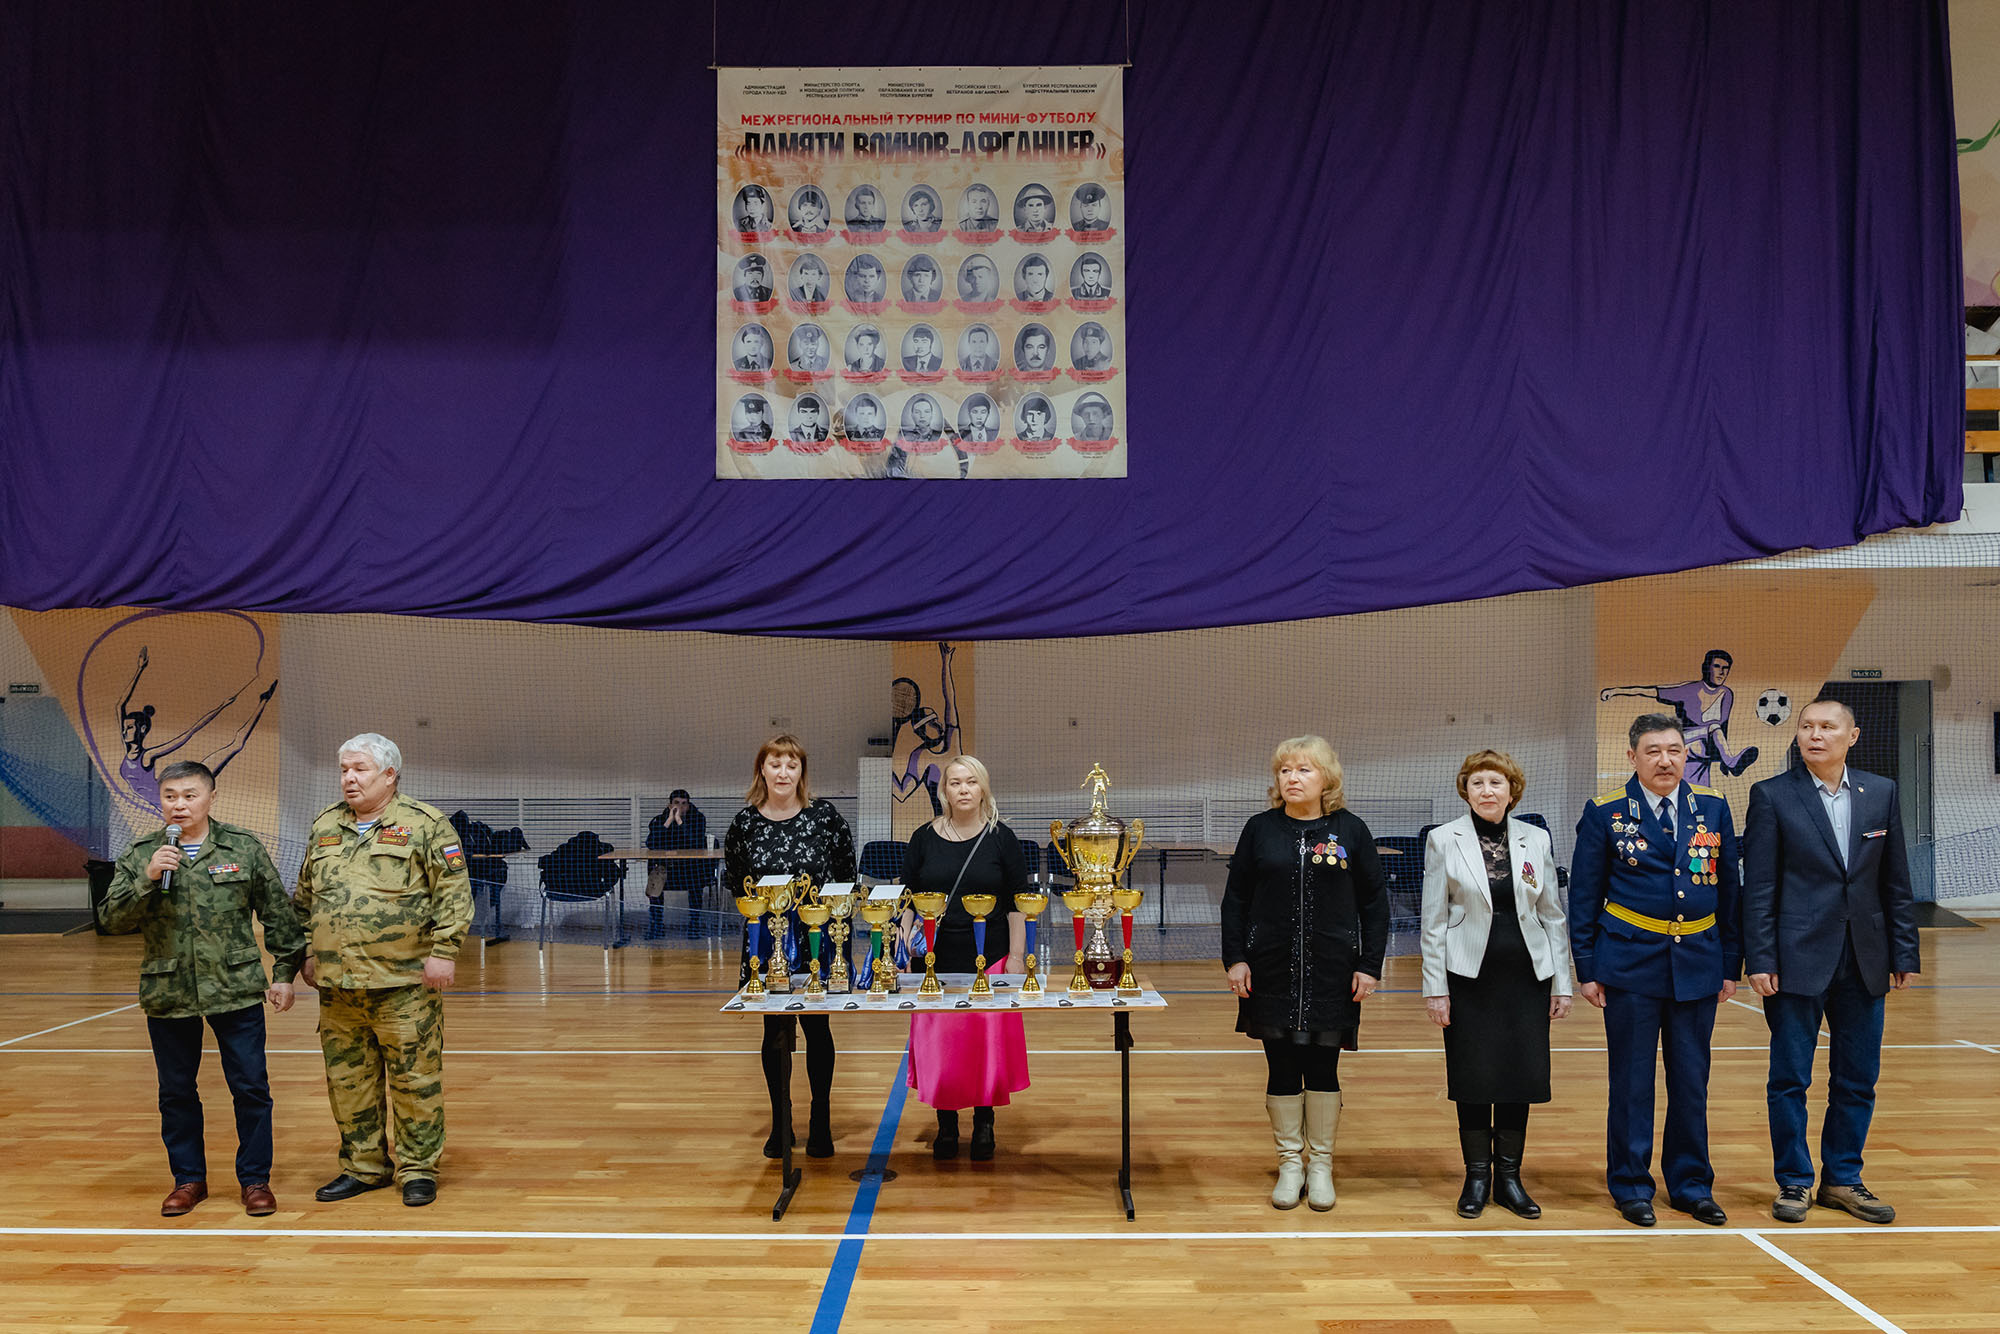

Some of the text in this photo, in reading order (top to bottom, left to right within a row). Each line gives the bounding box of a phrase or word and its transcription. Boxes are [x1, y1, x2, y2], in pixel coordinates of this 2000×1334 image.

[741, 111, 1097, 127] МЕЖРЕГИОНАЛЬНЫЙ ТУРНИР ПО МИНИ-ФУТБОЛУ
[734, 131, 845, 162] «ПАМЯТИ
